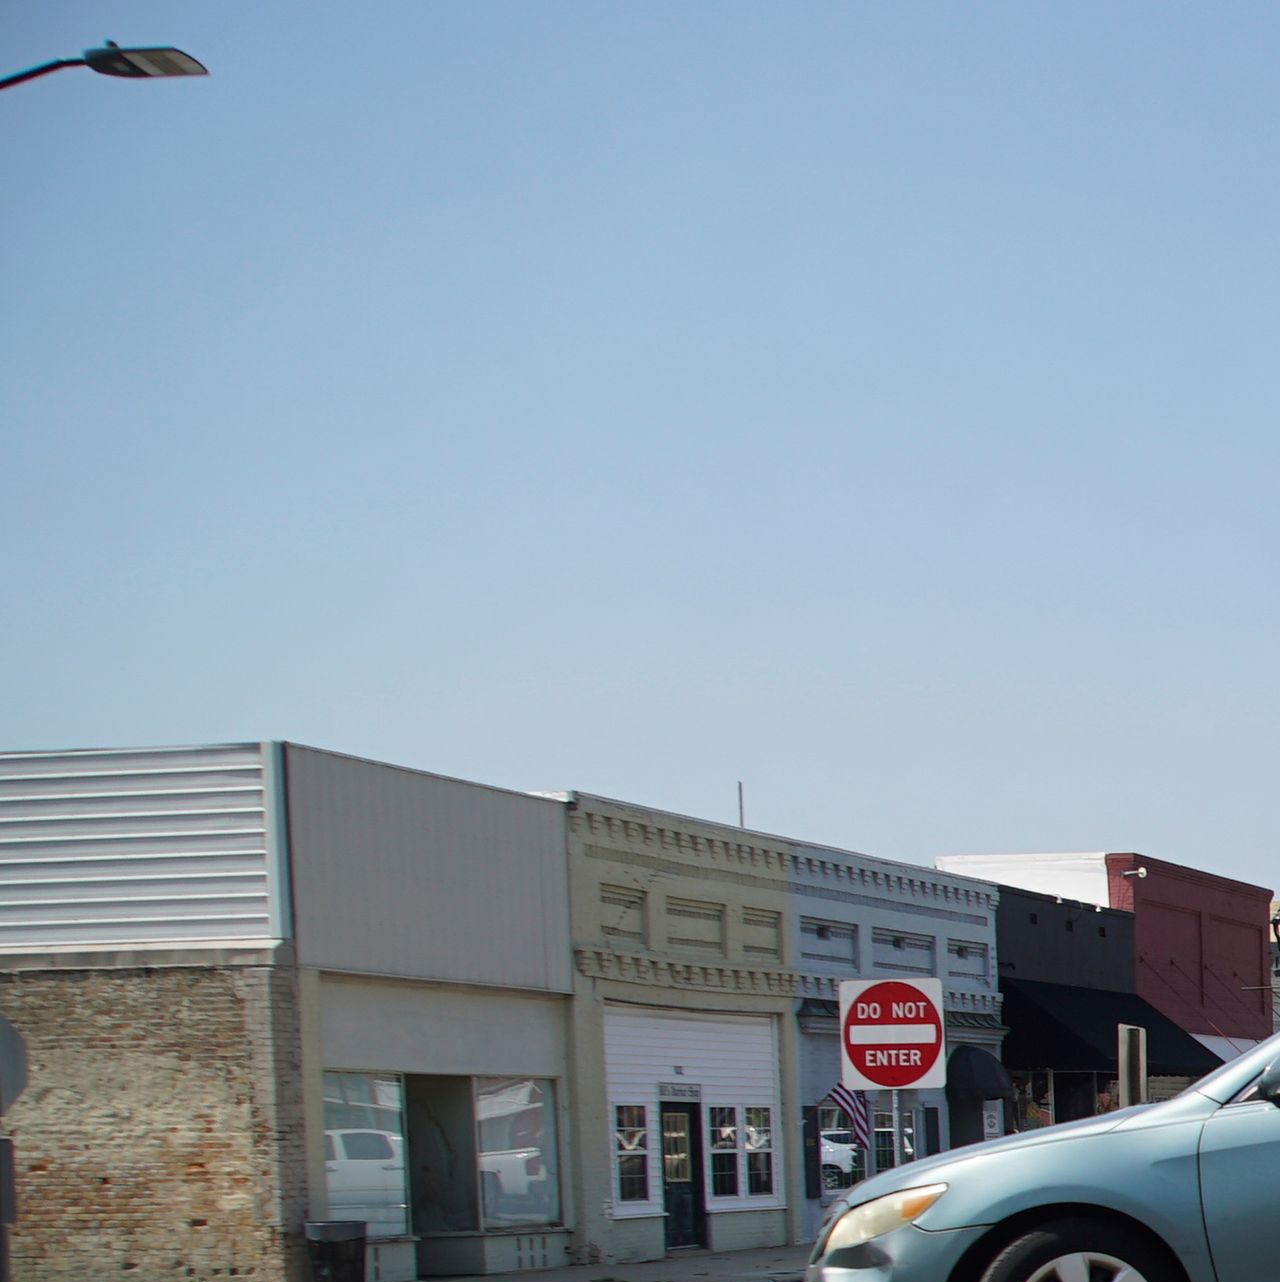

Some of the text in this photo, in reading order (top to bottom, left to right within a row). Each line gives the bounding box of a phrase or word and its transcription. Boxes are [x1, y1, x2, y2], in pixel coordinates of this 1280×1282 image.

[857, 1002, 927, 1019] DO NOT
[865, 1050, 922, 1067] ENTER
